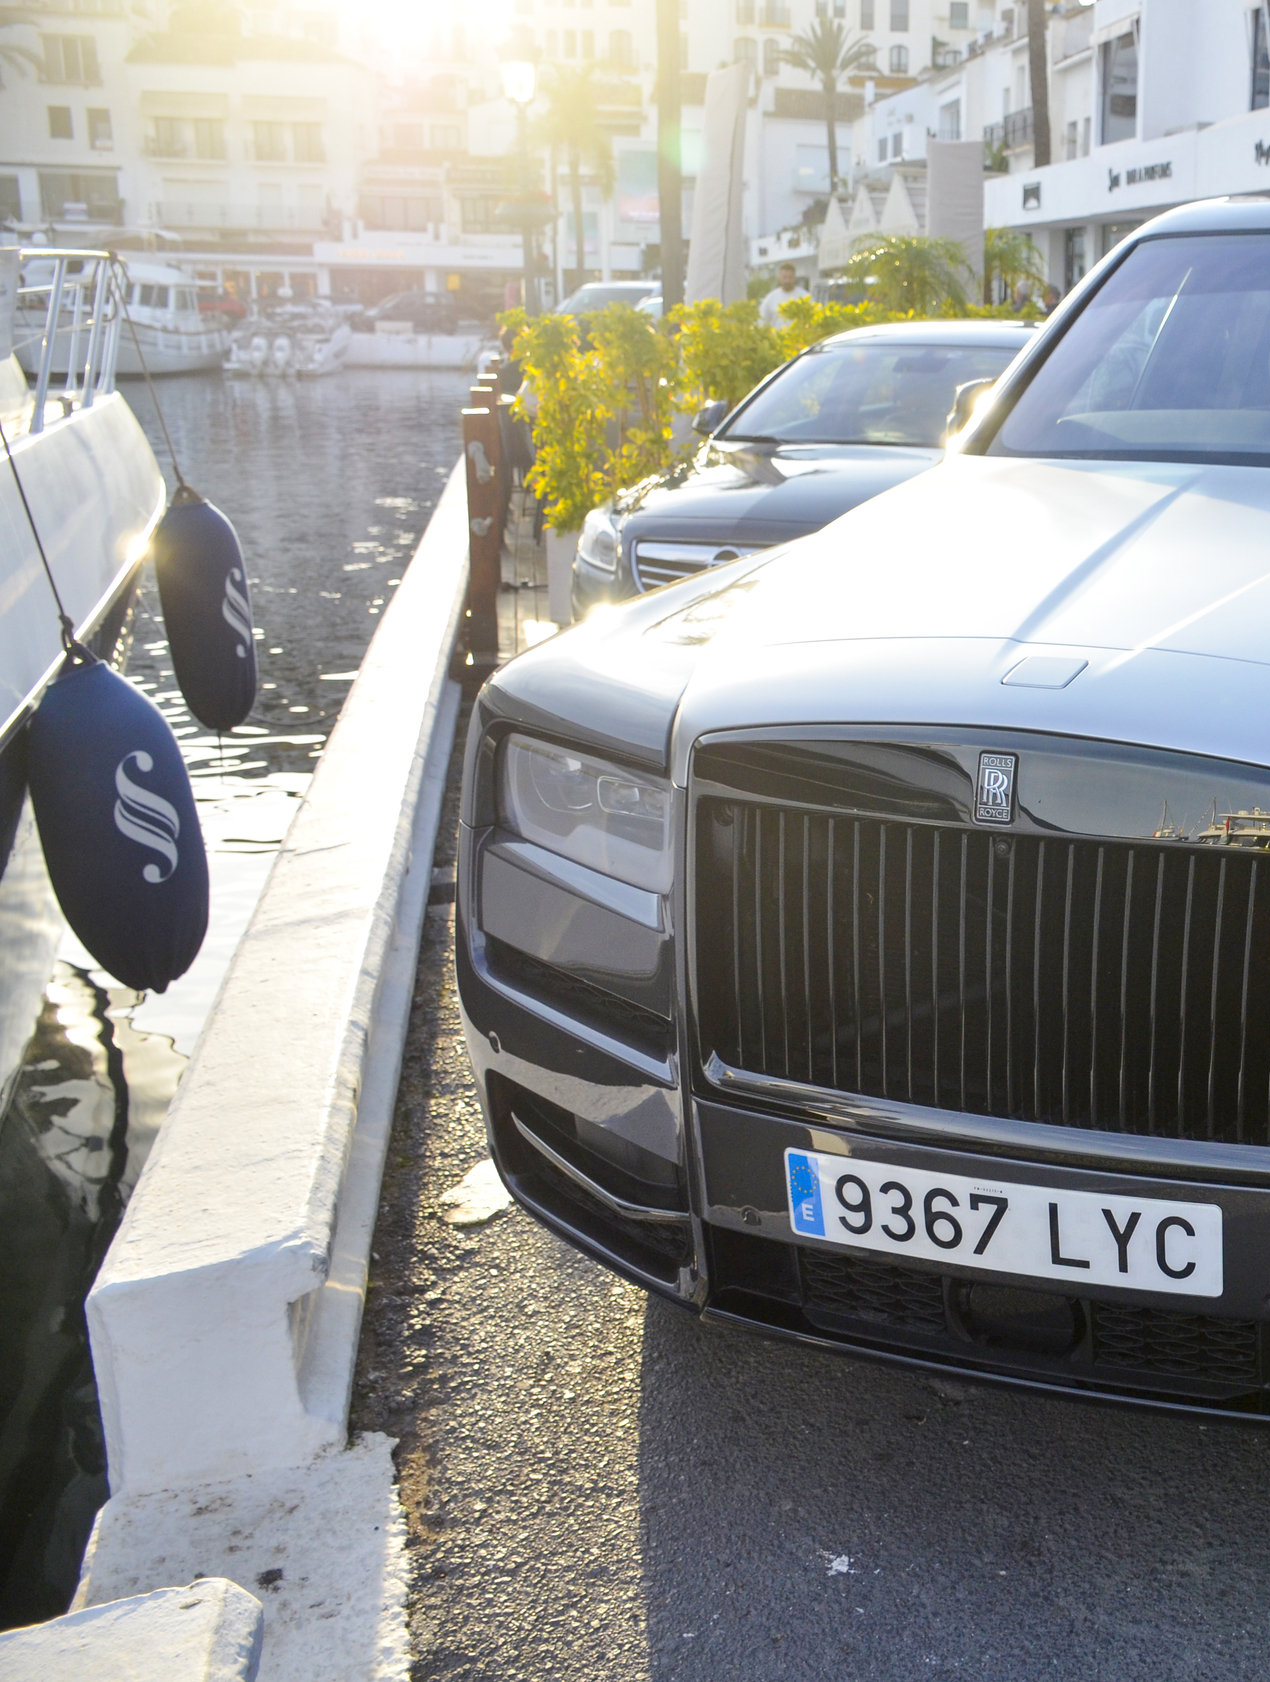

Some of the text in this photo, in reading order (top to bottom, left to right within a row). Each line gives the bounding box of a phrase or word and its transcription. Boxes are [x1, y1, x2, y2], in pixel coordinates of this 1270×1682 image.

[983, 757, 1012, 767] ROLLS
[979, 808, 1008, 818] ROYCE
[801, 1203, 815, 1222] E
[834, 1173, 1197, 1280] 9367 LYC
